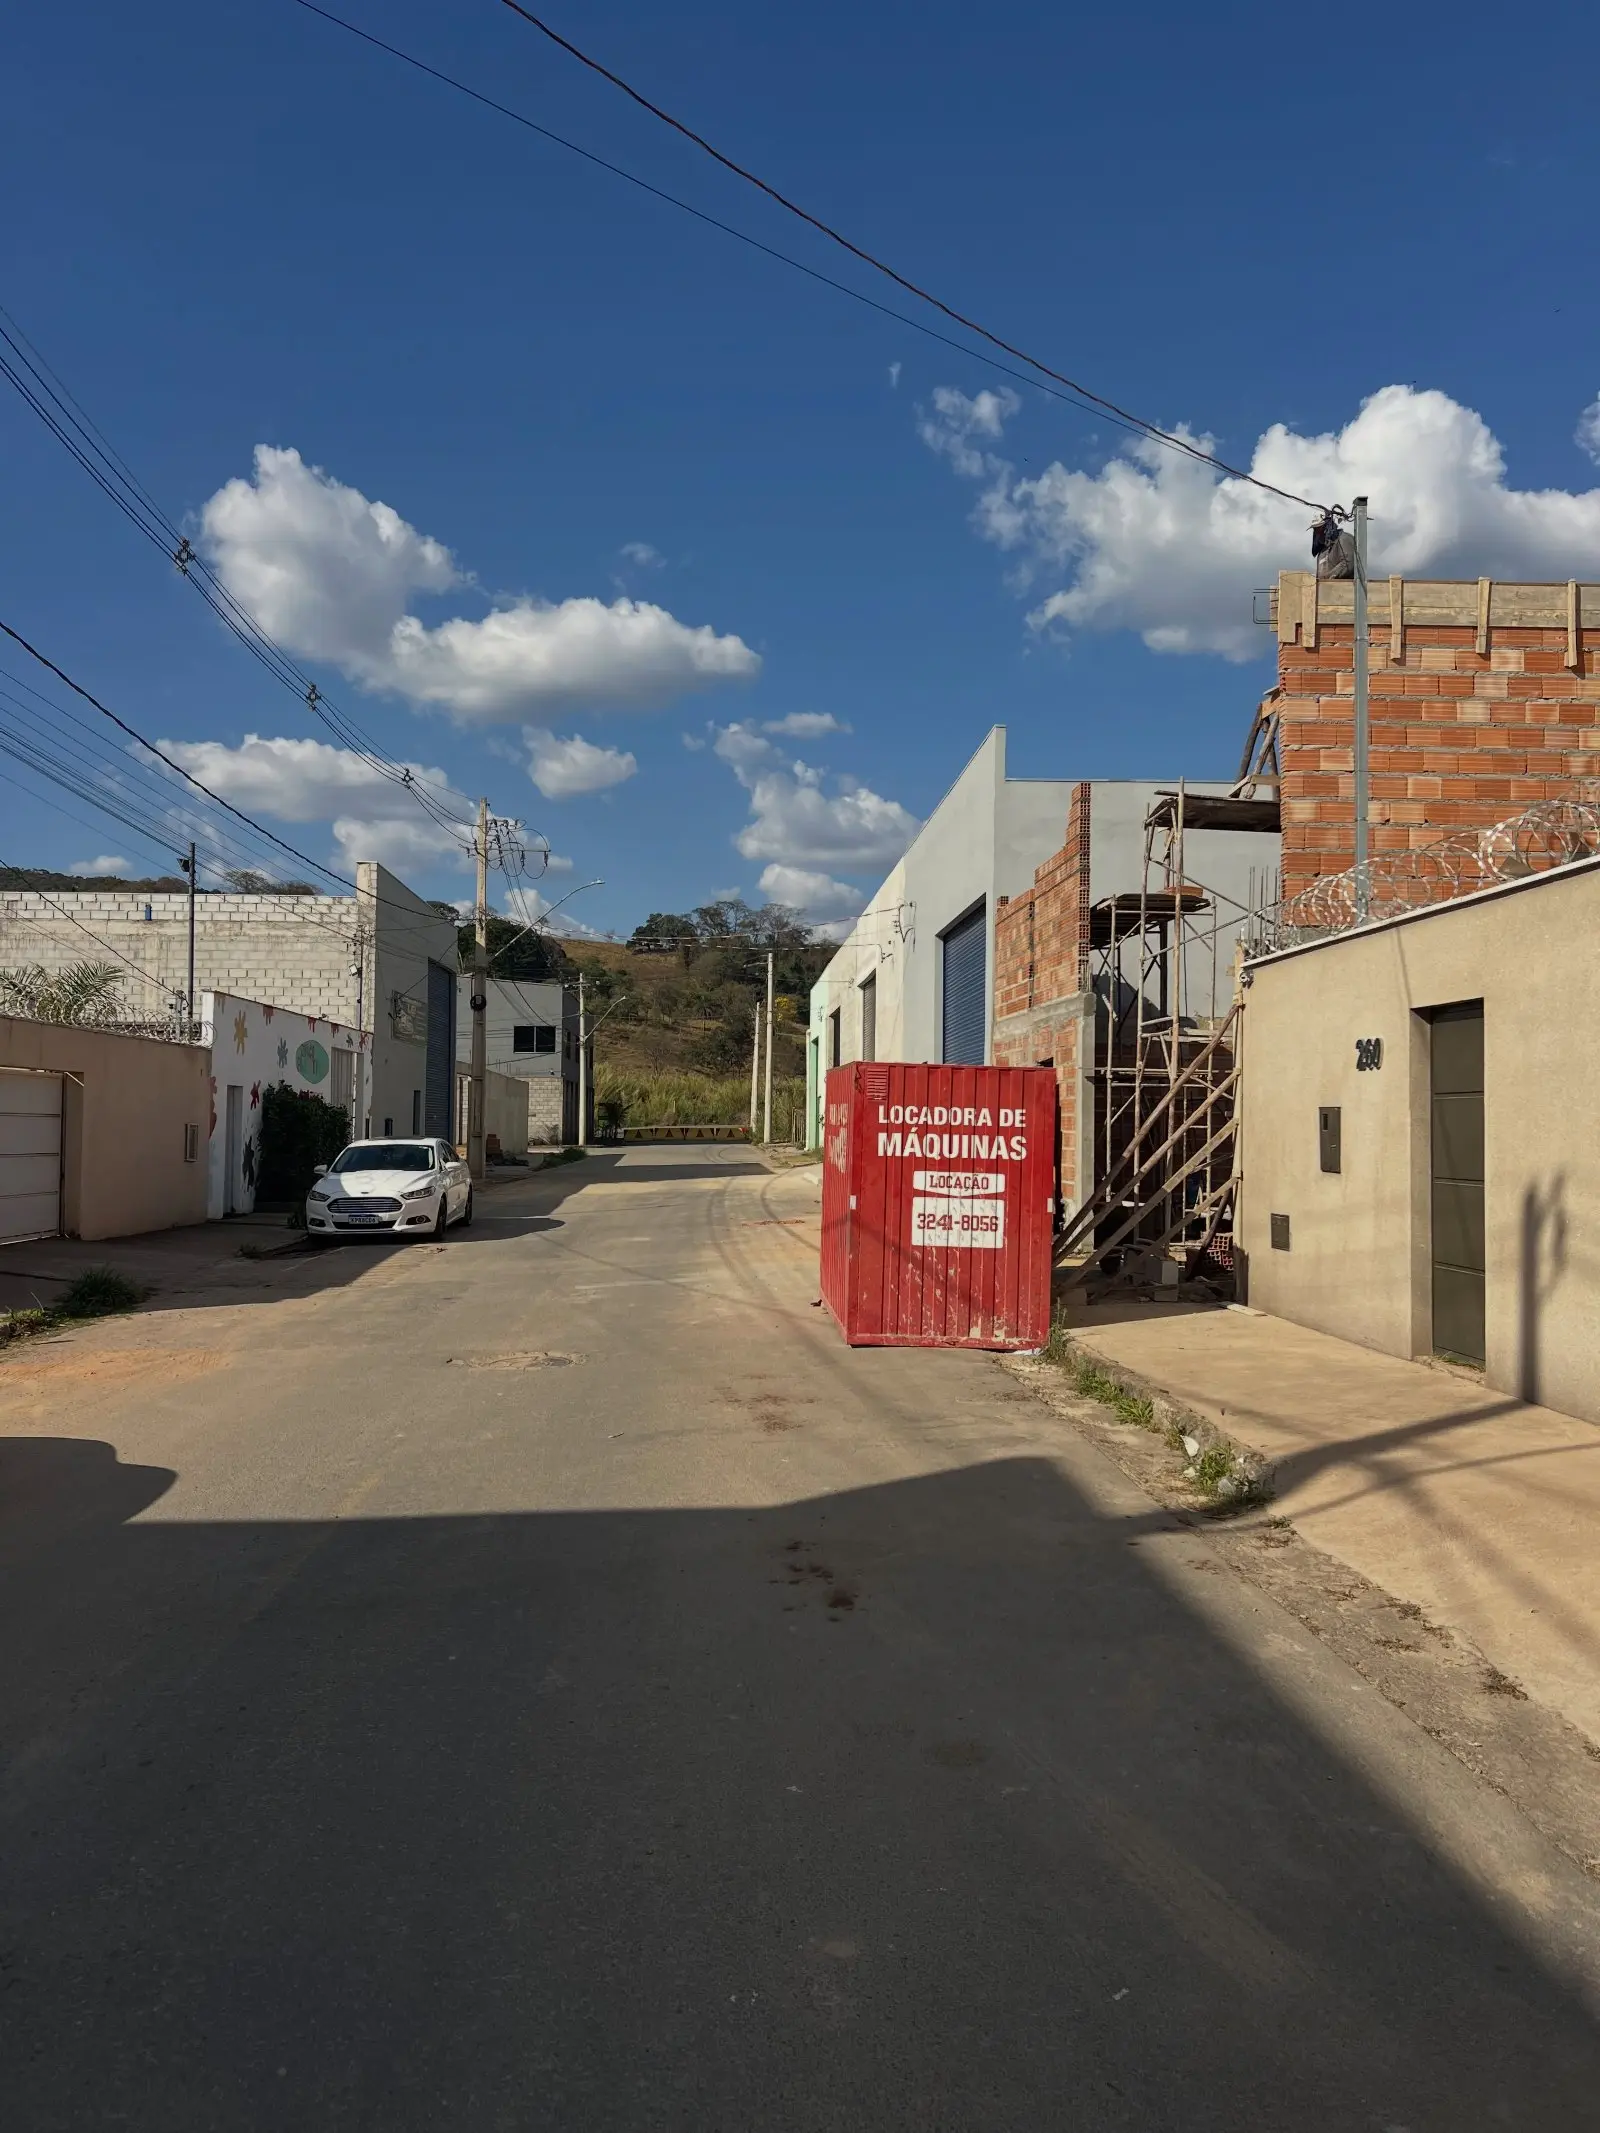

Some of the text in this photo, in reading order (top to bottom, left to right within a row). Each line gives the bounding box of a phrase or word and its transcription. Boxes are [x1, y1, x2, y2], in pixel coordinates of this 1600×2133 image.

[878, 1105, 1027, 1128] LOCADORA DE
[877, 1127, 1027, 1161] MÁQUINAS
[929, 1174, 989, 1192] LOCAÇÃO
[917, 1213, 999, 1232] 3241-8056
